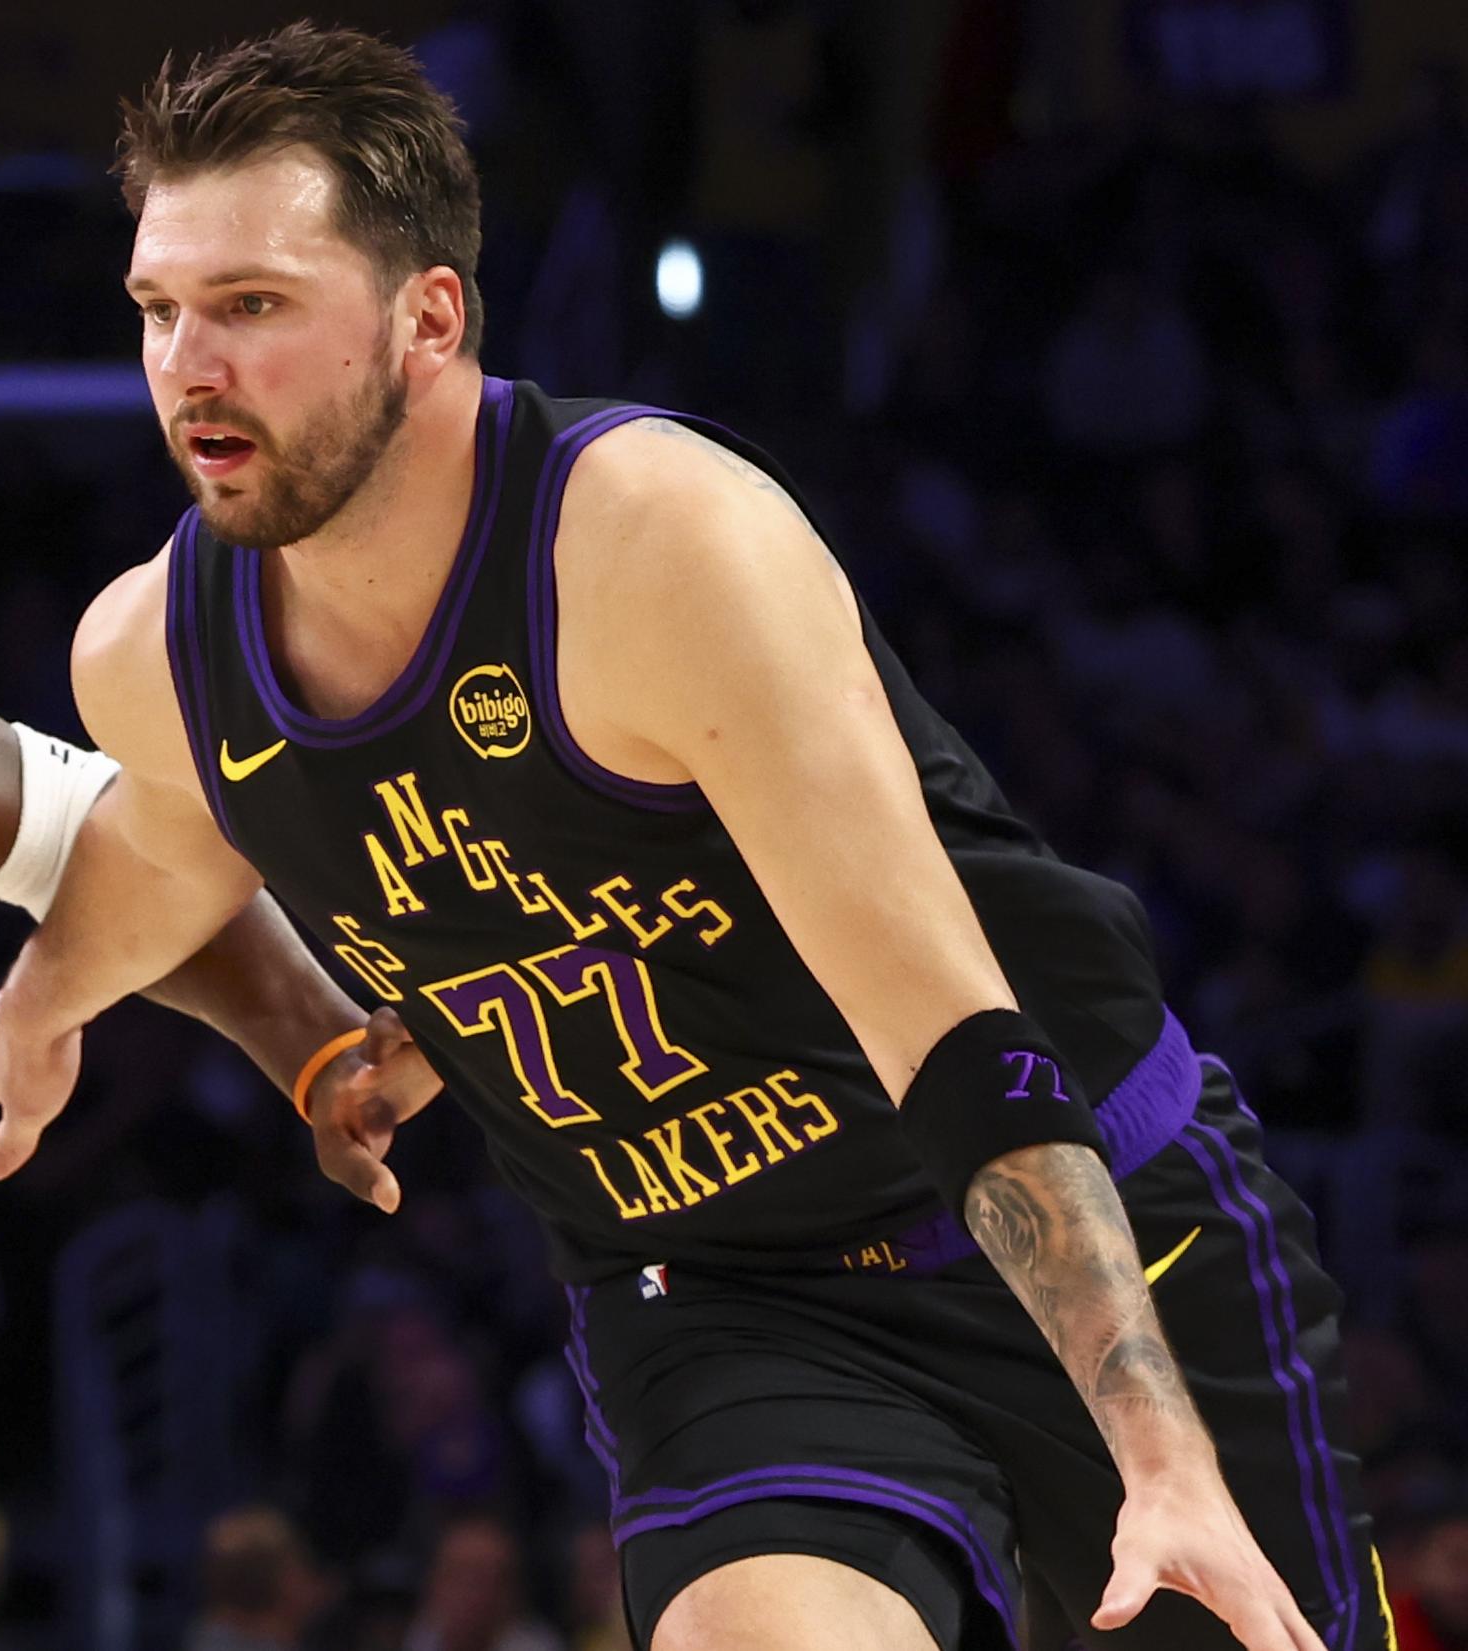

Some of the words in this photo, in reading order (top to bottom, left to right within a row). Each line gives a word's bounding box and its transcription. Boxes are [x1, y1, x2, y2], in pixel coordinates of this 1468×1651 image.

[458, 689, 526, 728] bibigo
[364, 772, 733, 948] ANGELES
[332, 915, 406, 1002] OS
[418, 944, 710, 1128] 77
[1000, 1051, 1070, 1102] 77
[580, 1069, 838, 1219] LAKERS
